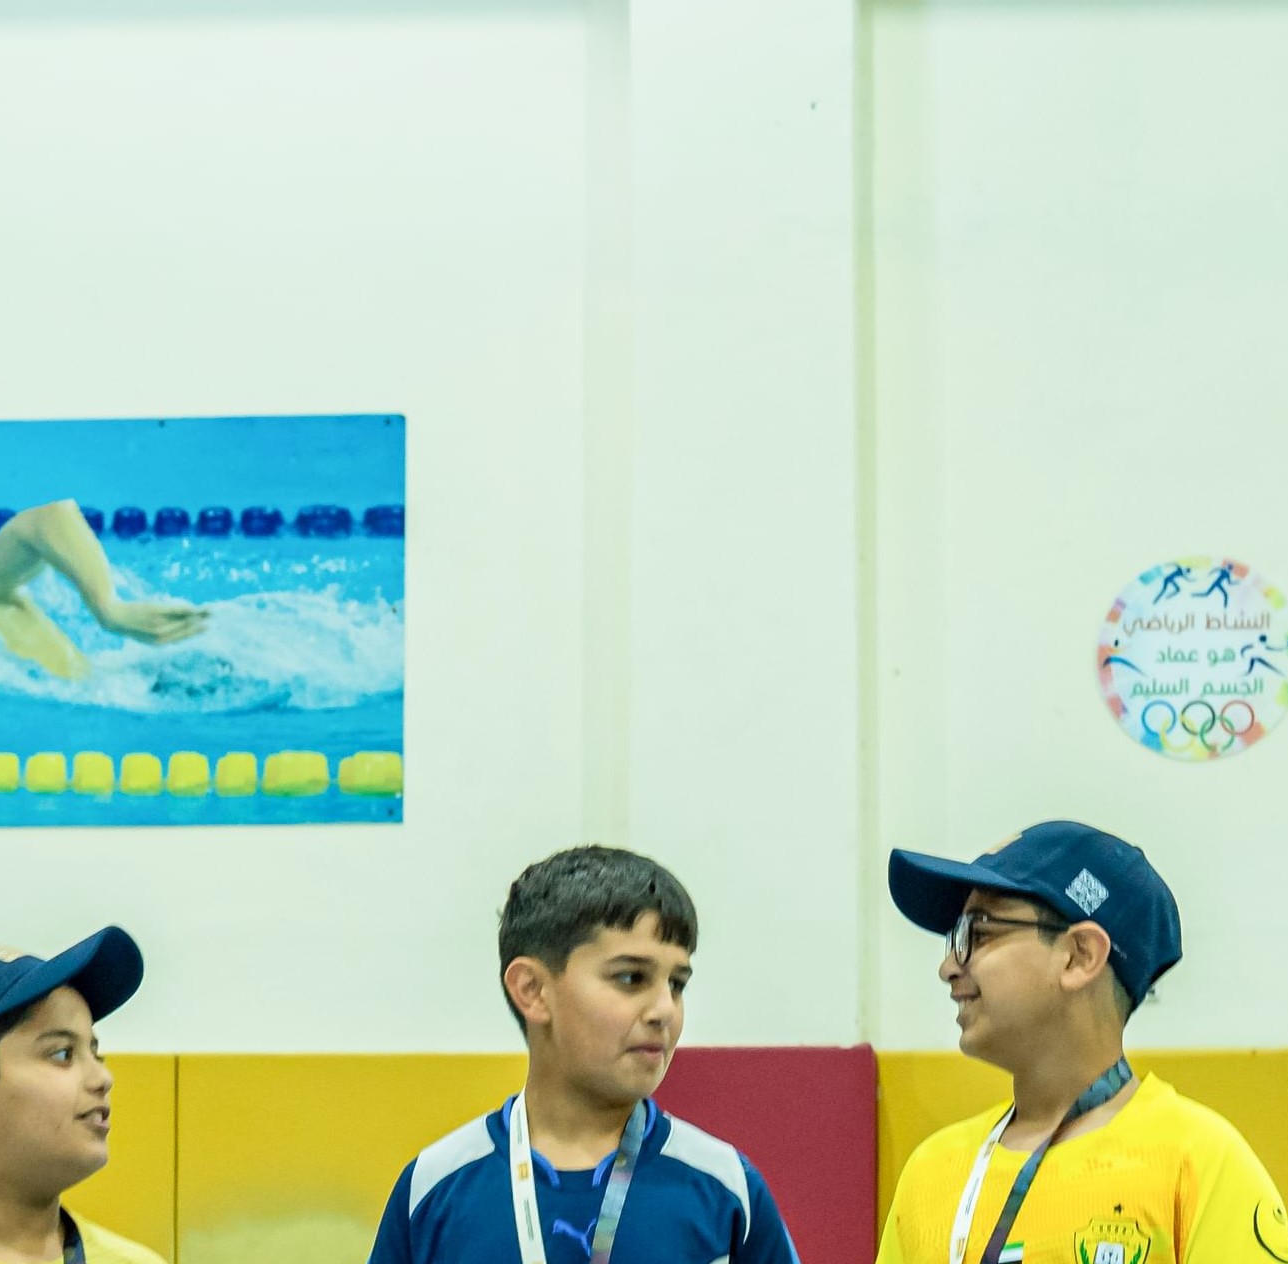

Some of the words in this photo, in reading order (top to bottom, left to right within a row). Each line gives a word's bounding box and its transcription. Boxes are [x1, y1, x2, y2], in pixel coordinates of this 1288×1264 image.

[1123, 613, 1195, 637] الرياضي
[1205, 610, 1271, 630] النشاط
[1156, 646, 1199, 664] عماد
[1207, 650, 1236, 666] هو
[1130, 678, 1189, 699] السليم
[1201, 678, 1264, 698] الجسم
